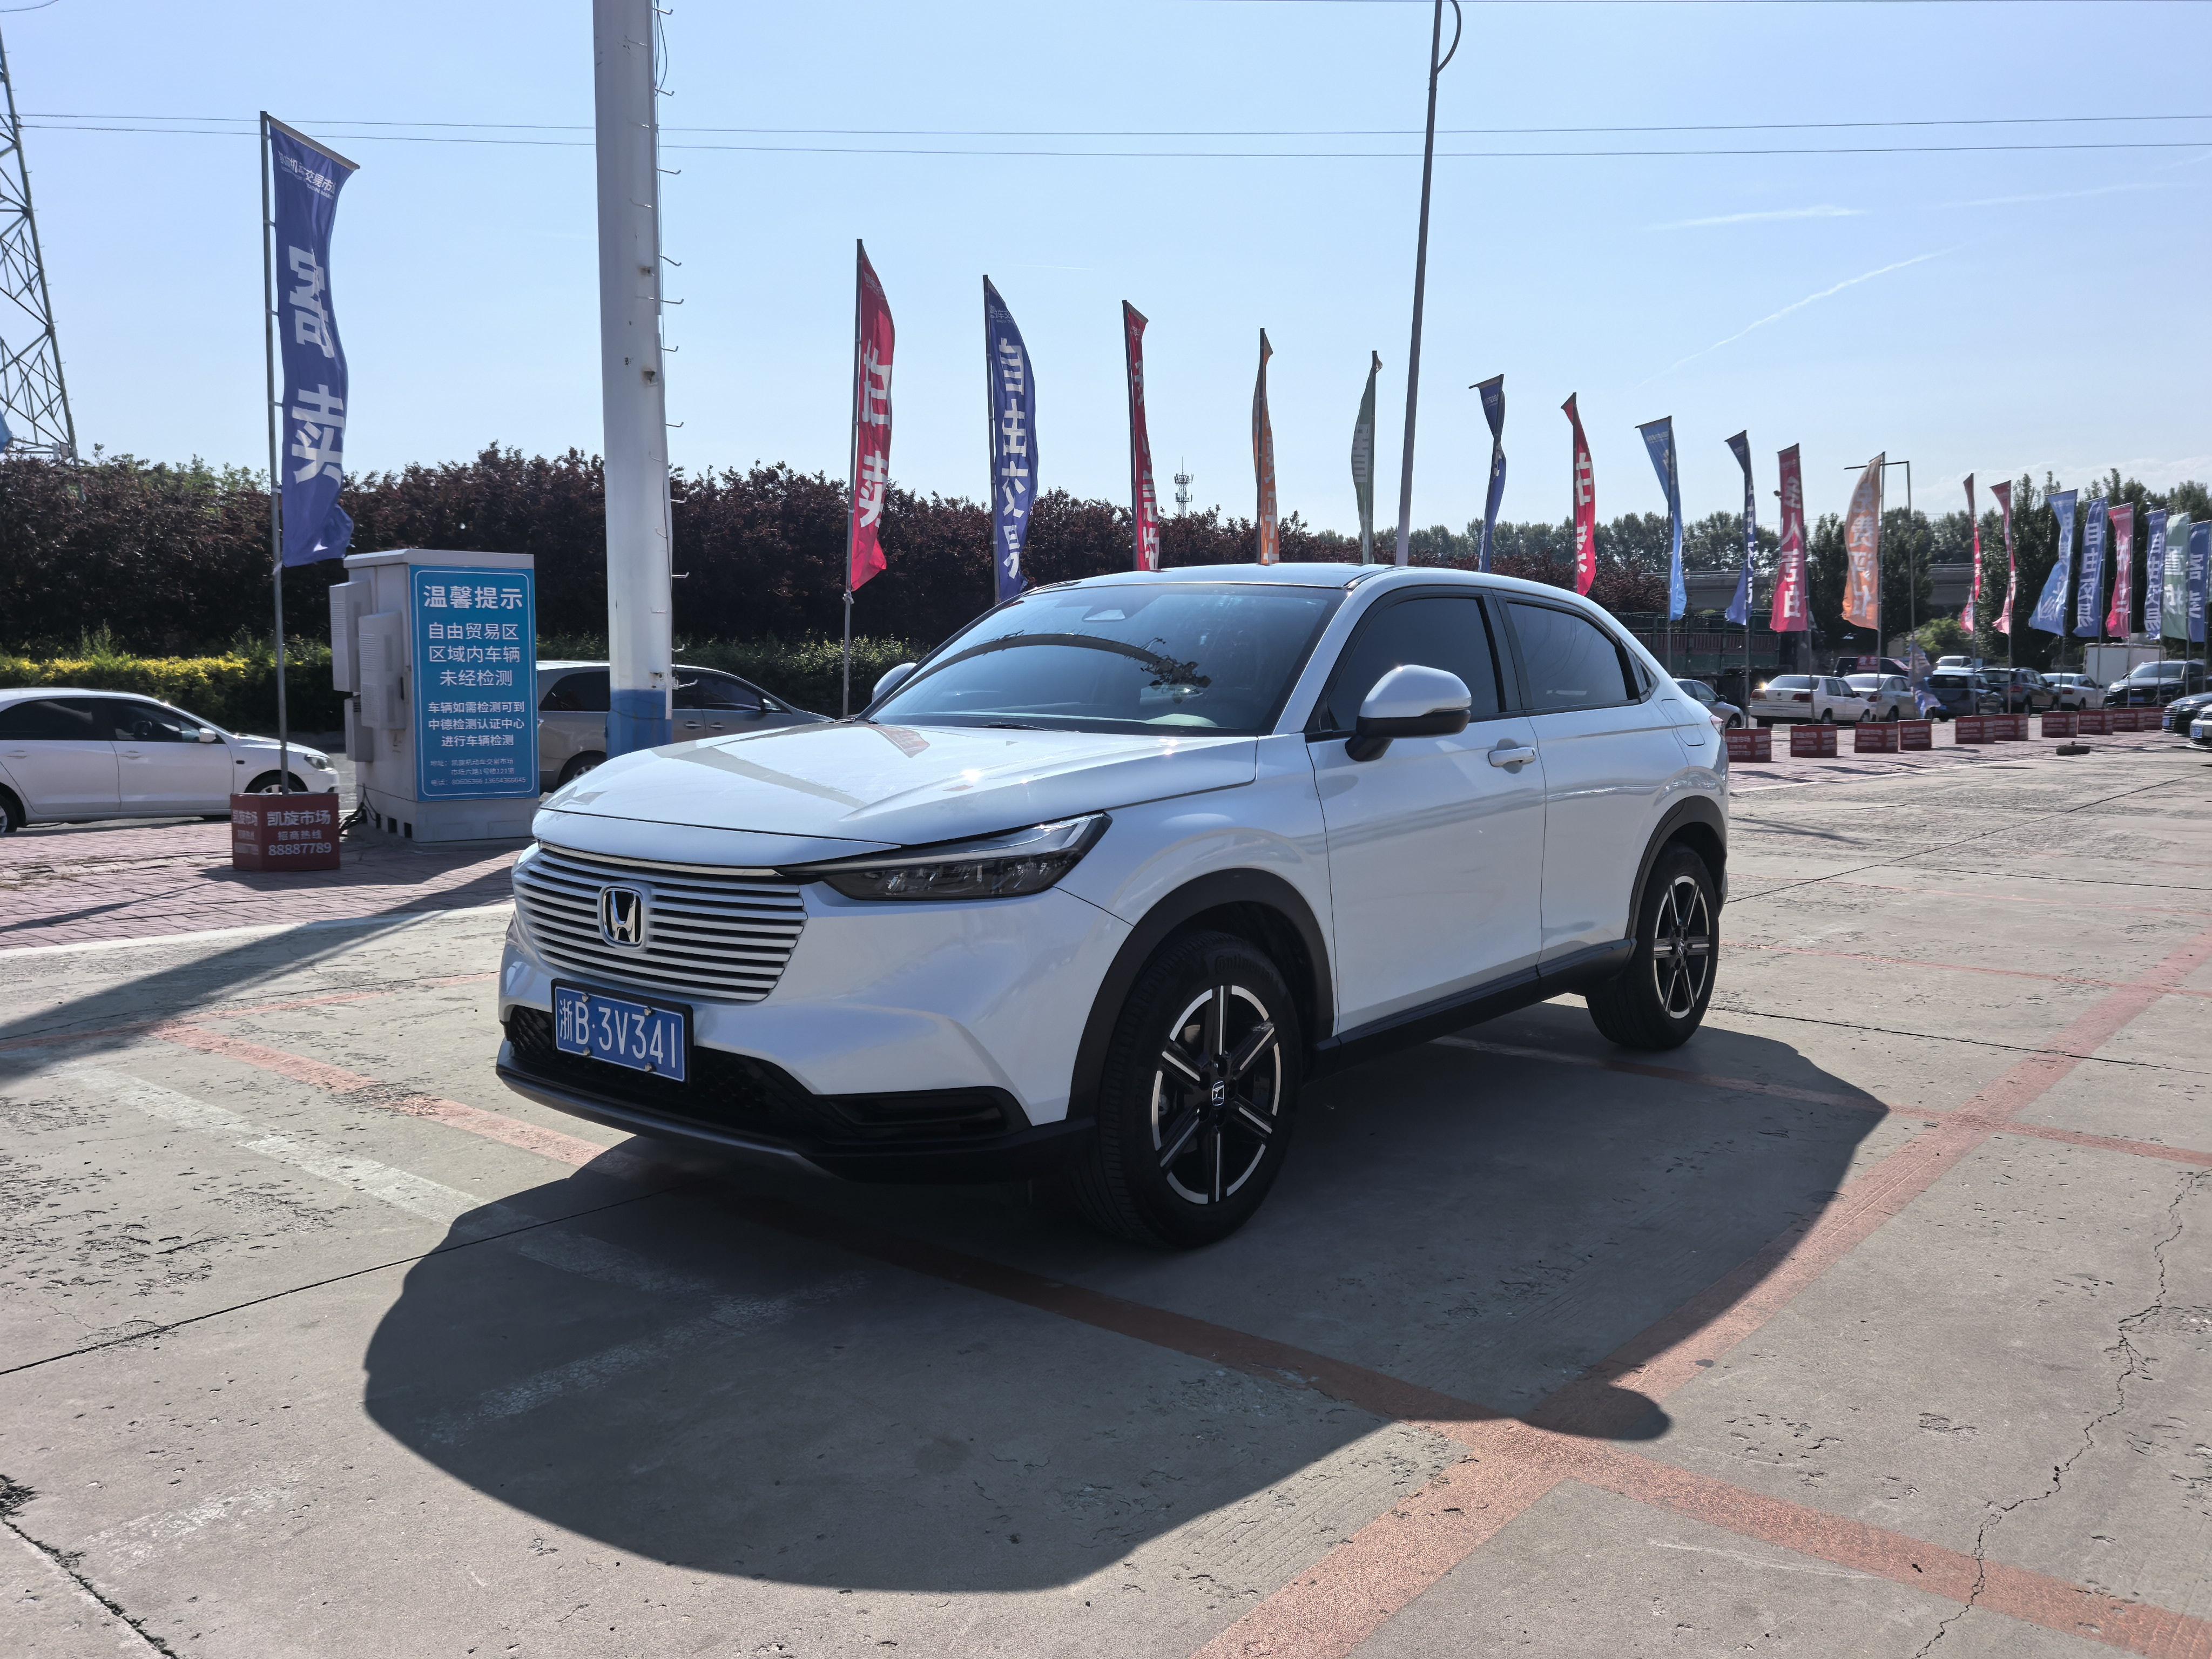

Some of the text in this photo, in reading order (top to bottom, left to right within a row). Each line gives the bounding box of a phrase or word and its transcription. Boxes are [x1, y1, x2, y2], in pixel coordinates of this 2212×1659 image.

[423, 584, 523, 610] 温馨提示
[429, 623, 520, 640] 自由贸易区
[429, 646, 521, 664] 区域内车辆
[440, 669, 513, 687] 未经检测
[428, 700, 525, 714] 车辆如需检测可到
[428, 718, 525, 731] 中德检测认证中心
[441, 734, 514, 747] 进行车辆检测
[267, 810, 332, 826] 凯旋市场
[278, 830, 322, 841] 招商热线
[268, 842, 332, 856] 88887789
